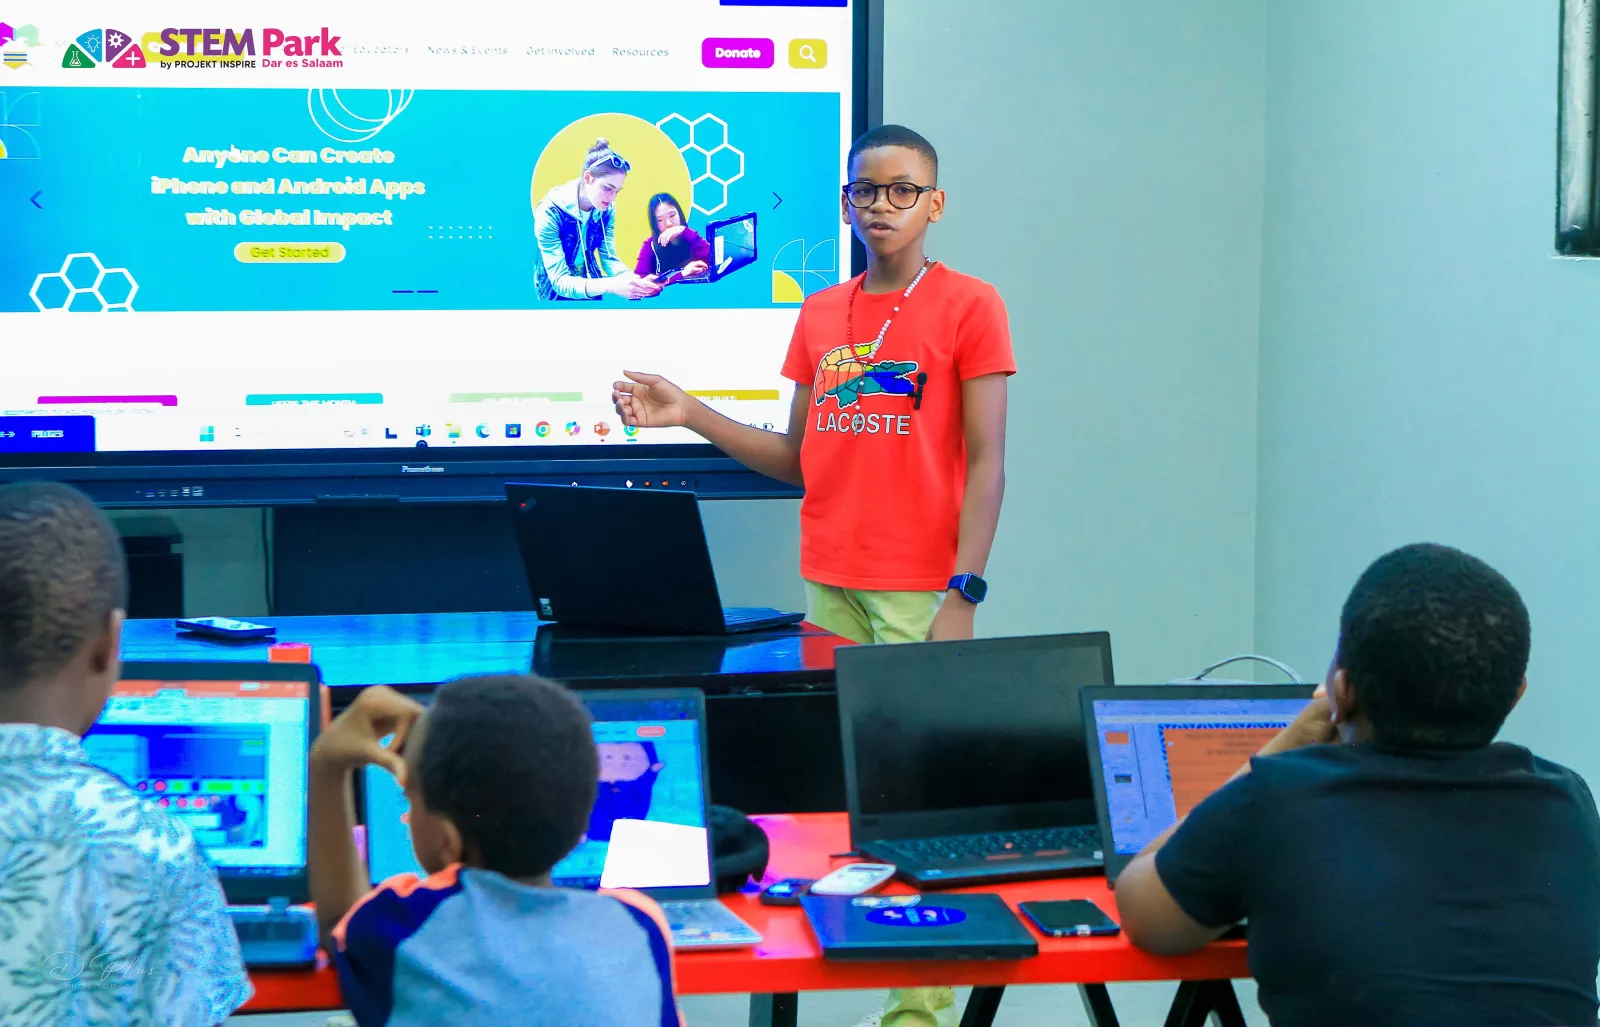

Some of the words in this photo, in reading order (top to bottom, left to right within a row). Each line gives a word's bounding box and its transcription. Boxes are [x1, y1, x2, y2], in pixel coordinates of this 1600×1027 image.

[525, 46, 545, 56] Get
[612, 47, 670, 57] Resources
[714, 46, 762, 60] Donate
[182, 146, 270, 168] Anyone
[271, 147, 317, 163] Can
[320, 147, 396, 164] Create
[150, 175, 229, 194] iPhone
[230, 178, 275, 194] and
[277, 176, 367, 195] Android
[369, 178, 426, 200] Apps
[185, 207, 237, 225] with
[238, 209, 311, 226] Global
[312, 209, 394, 231] Impact
[249, 246, 276, 259] Get
[278, 246, 330, 259] Started
[816, 412, 911, 435] LACOSTE
